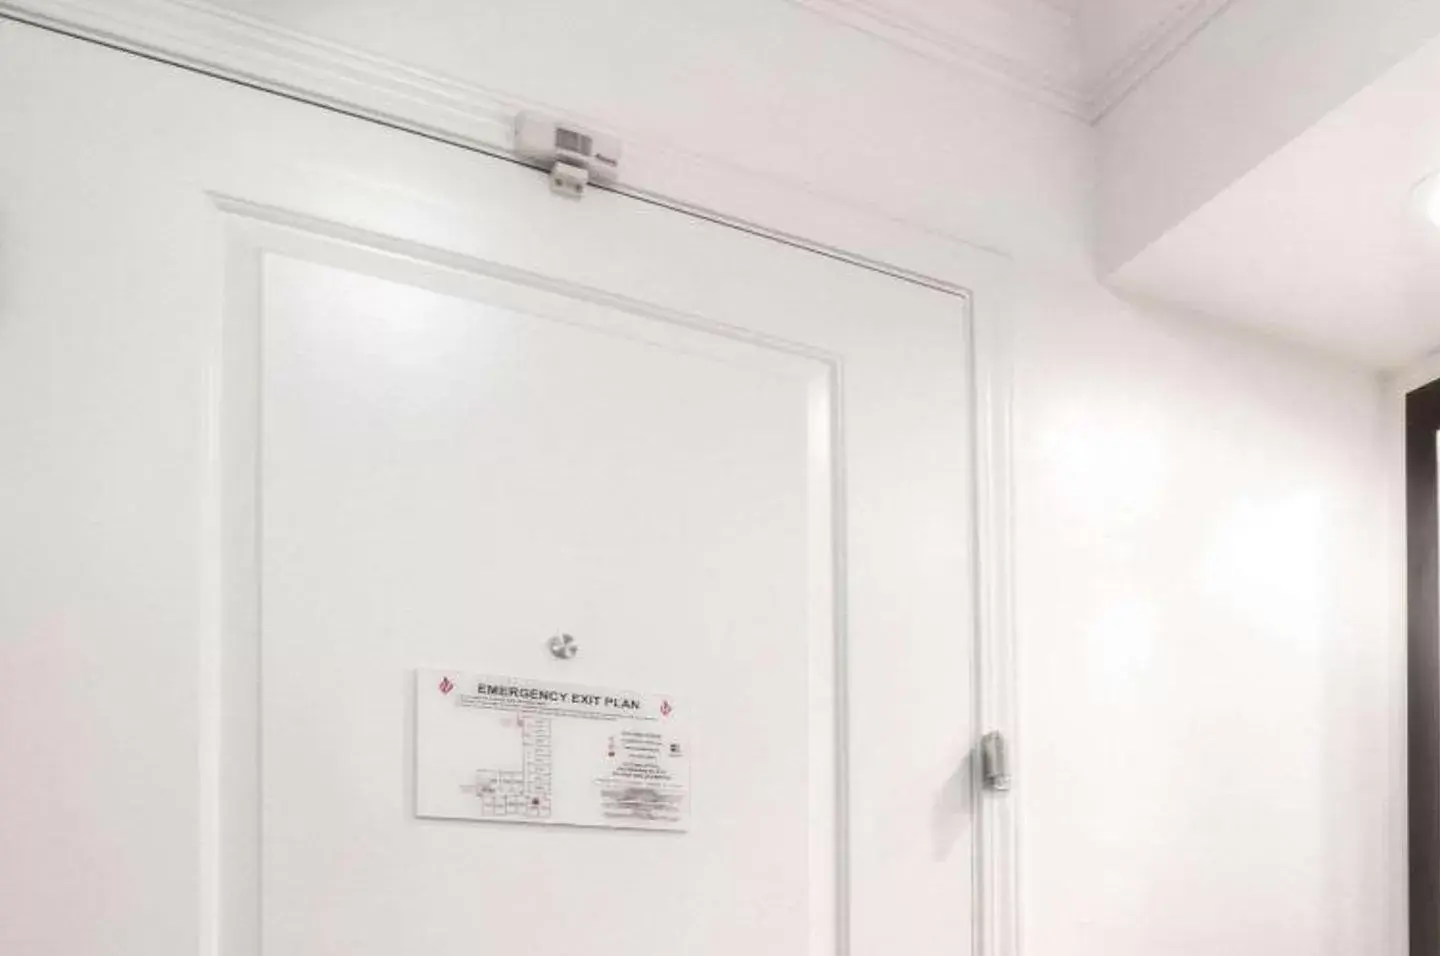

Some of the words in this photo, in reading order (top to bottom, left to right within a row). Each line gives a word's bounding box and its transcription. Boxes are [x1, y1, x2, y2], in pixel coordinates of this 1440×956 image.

[477, 683, 568, 702] EMERGENCY
[571, 694, 601, 706] EXIT
[604, 697, 640, 709] PLAN
